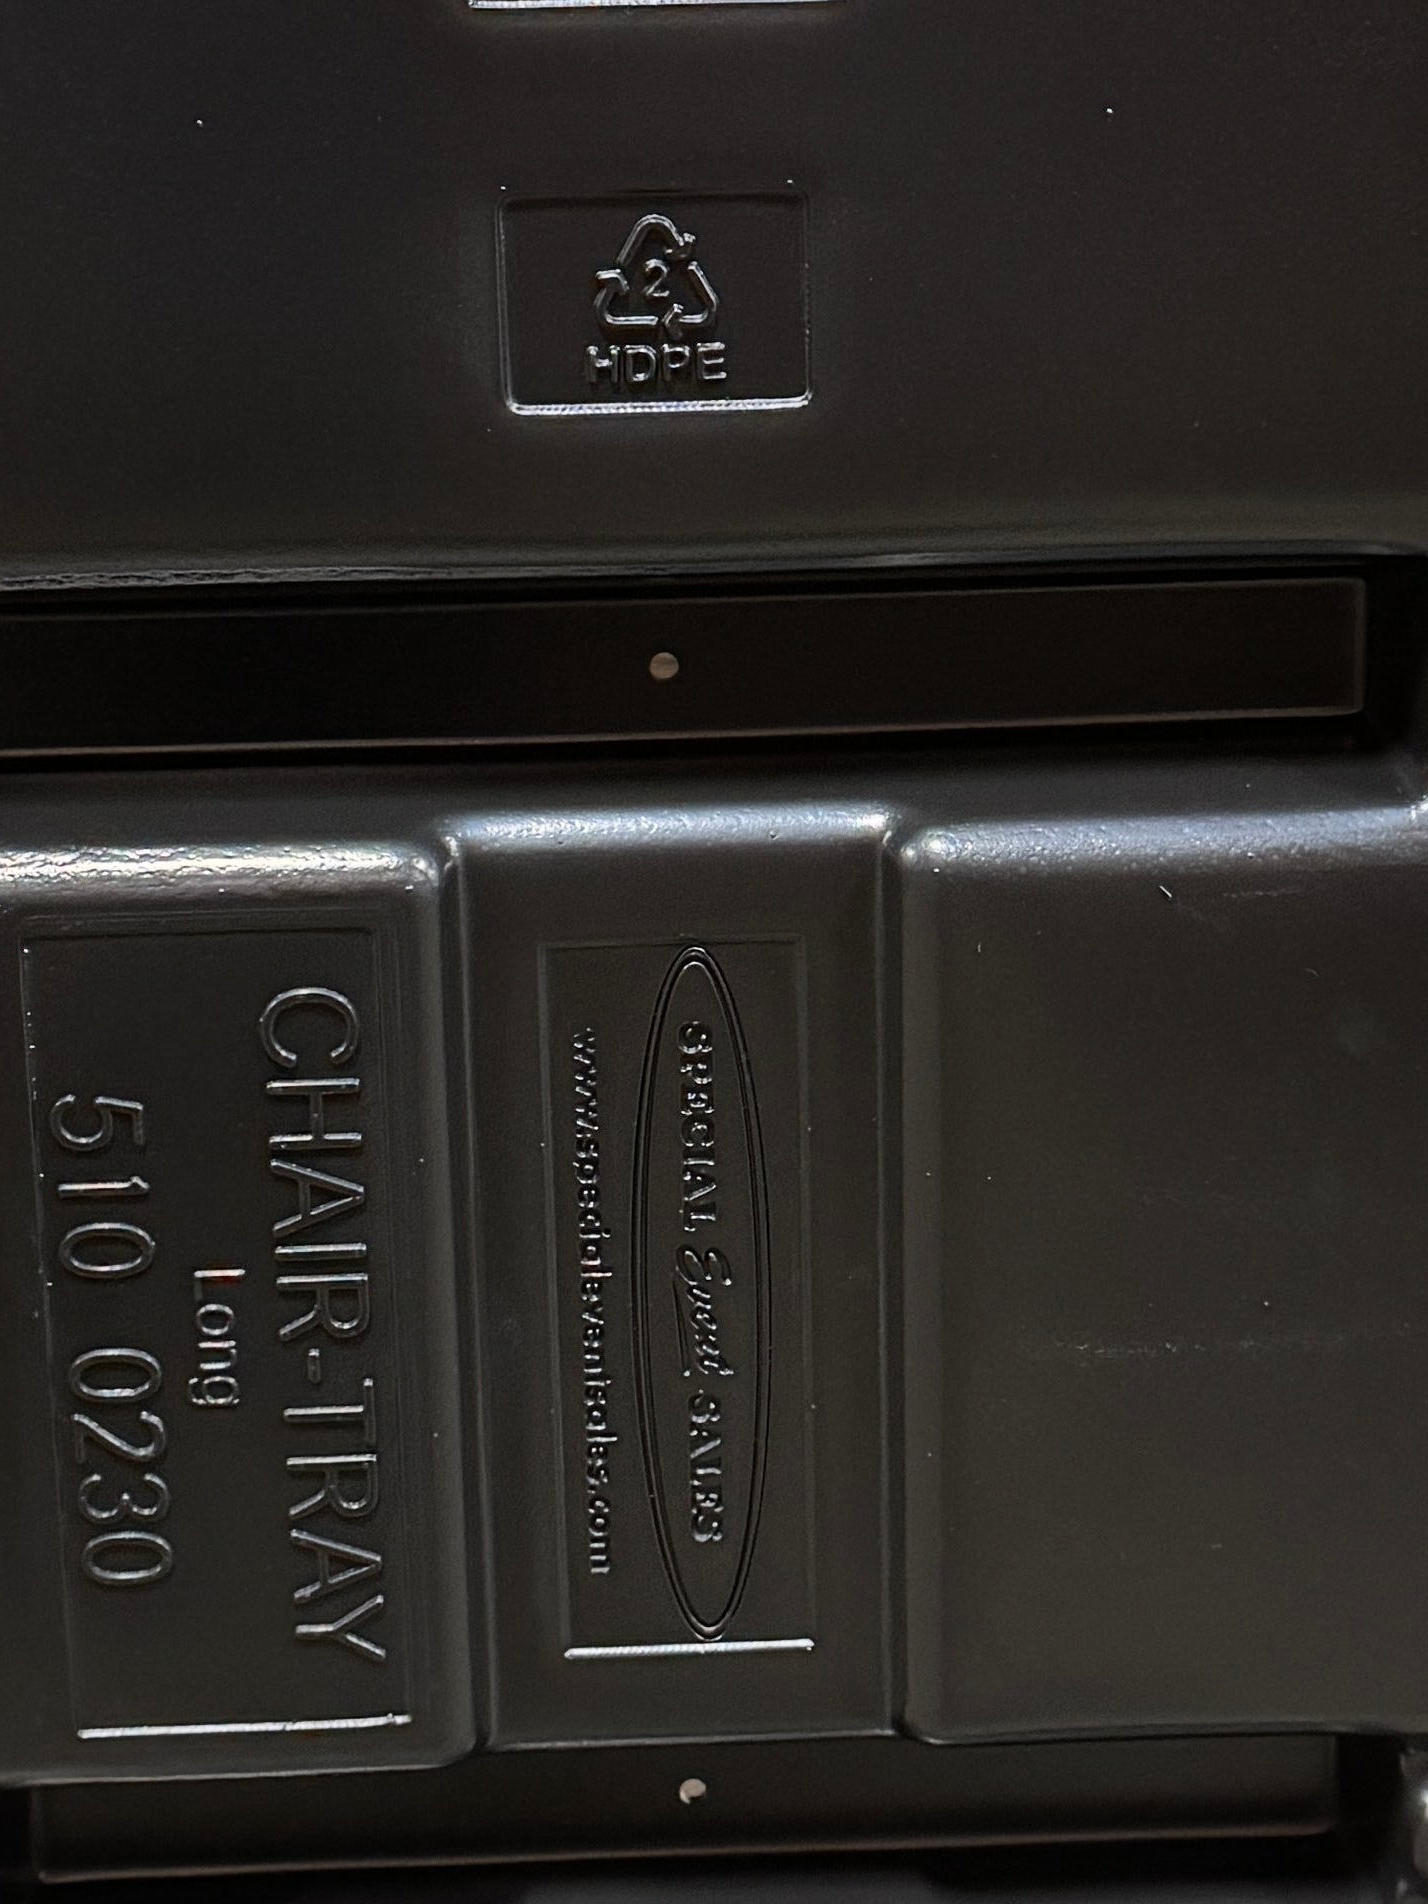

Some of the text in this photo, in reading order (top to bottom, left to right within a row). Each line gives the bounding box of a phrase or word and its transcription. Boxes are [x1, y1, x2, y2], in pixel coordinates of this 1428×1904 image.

[584, 342, 728, 384] HDPE
[49, 1093, 173, 1588] 510 0230
[188, 1258, 246, 1408] Long
[258, 985, 386, 1660] CHAIR-TRAY
[571, 1025, 619, 1576] www.specialeventsales.com
[674, 1020, 734, 1544] SPECIAL Event SALES
